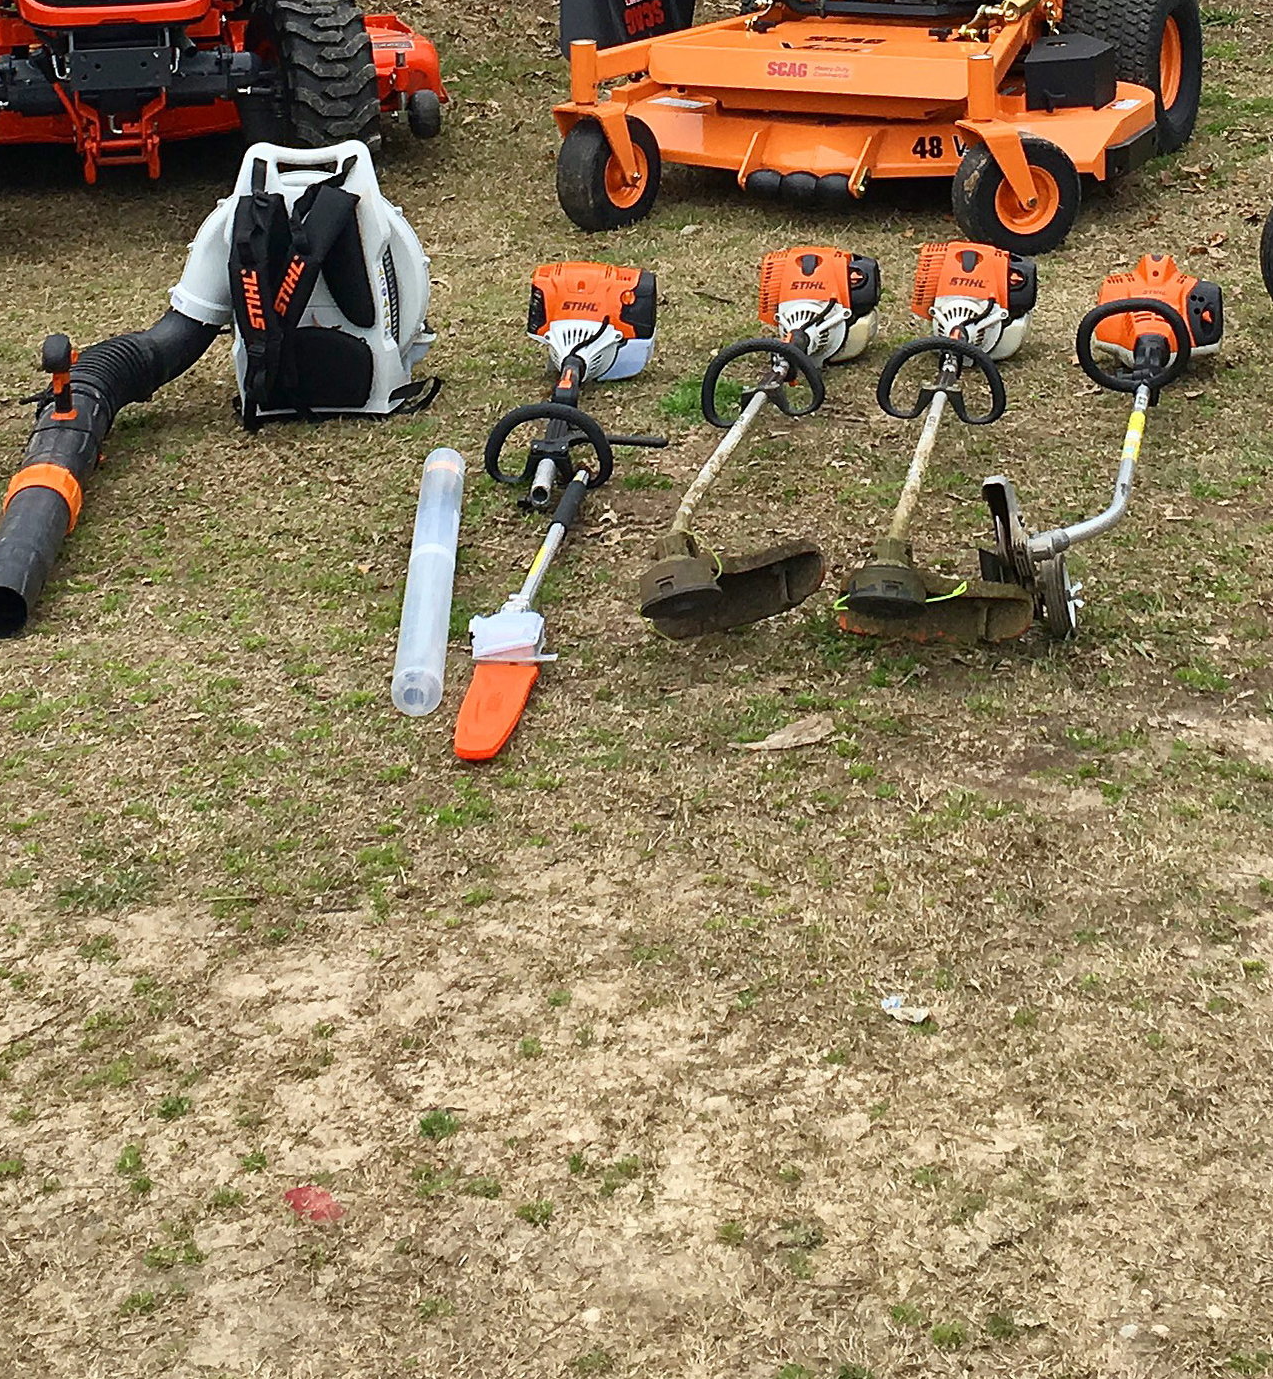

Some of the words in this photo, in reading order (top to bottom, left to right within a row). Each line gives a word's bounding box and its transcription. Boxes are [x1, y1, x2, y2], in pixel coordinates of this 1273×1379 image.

[767, 61, 808, 78] SCAG
[911, 135, 944, 159] 48
[273, 260, 306, 317] STIHL
[790, 280, 826, 291] STIHL
[949, 276, 987, 289] STIHL
[241, 270, 268, 331] STIHL
[561, 300, 599, 312] STIHL
